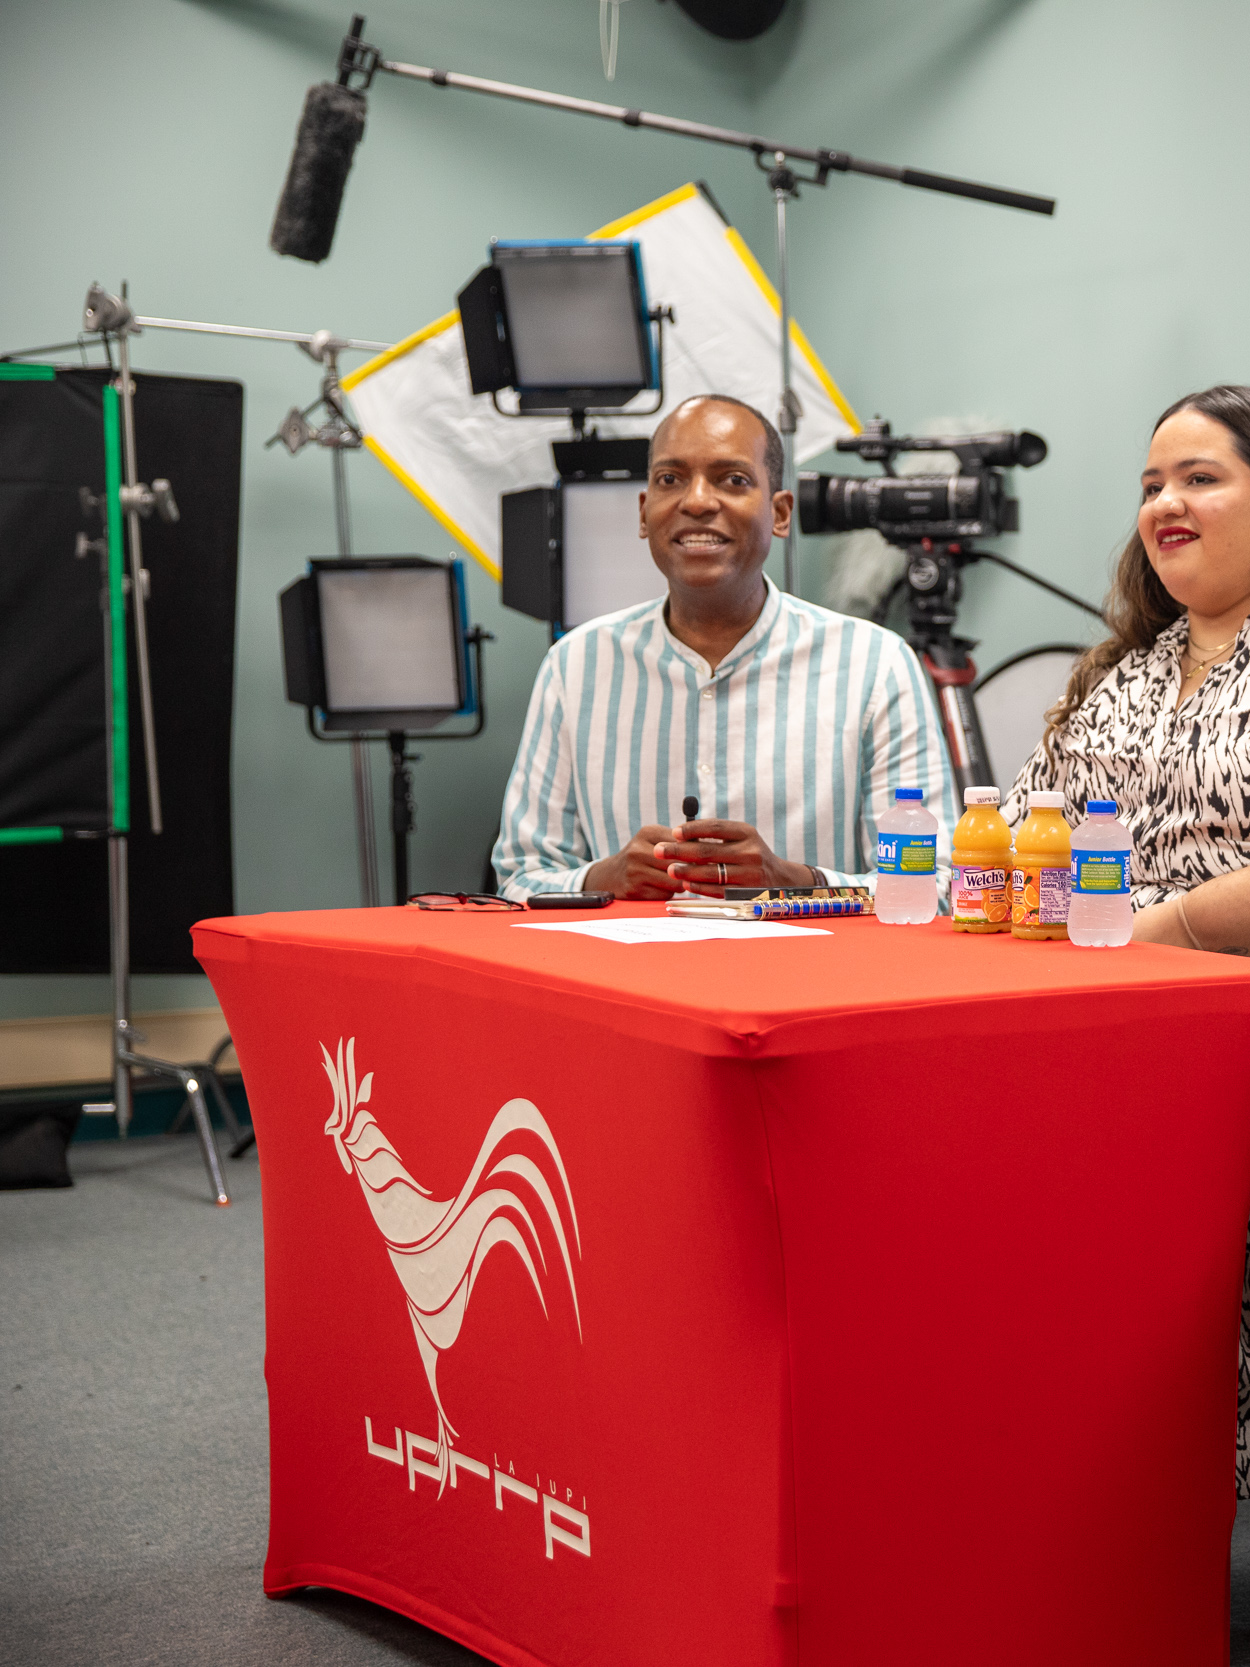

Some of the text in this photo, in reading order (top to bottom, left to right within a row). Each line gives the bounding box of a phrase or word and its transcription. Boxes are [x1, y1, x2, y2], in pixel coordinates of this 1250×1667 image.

[966, 872, 1004, 887] Welch's
[494, 1453, 587, 1510] LA IUPI
